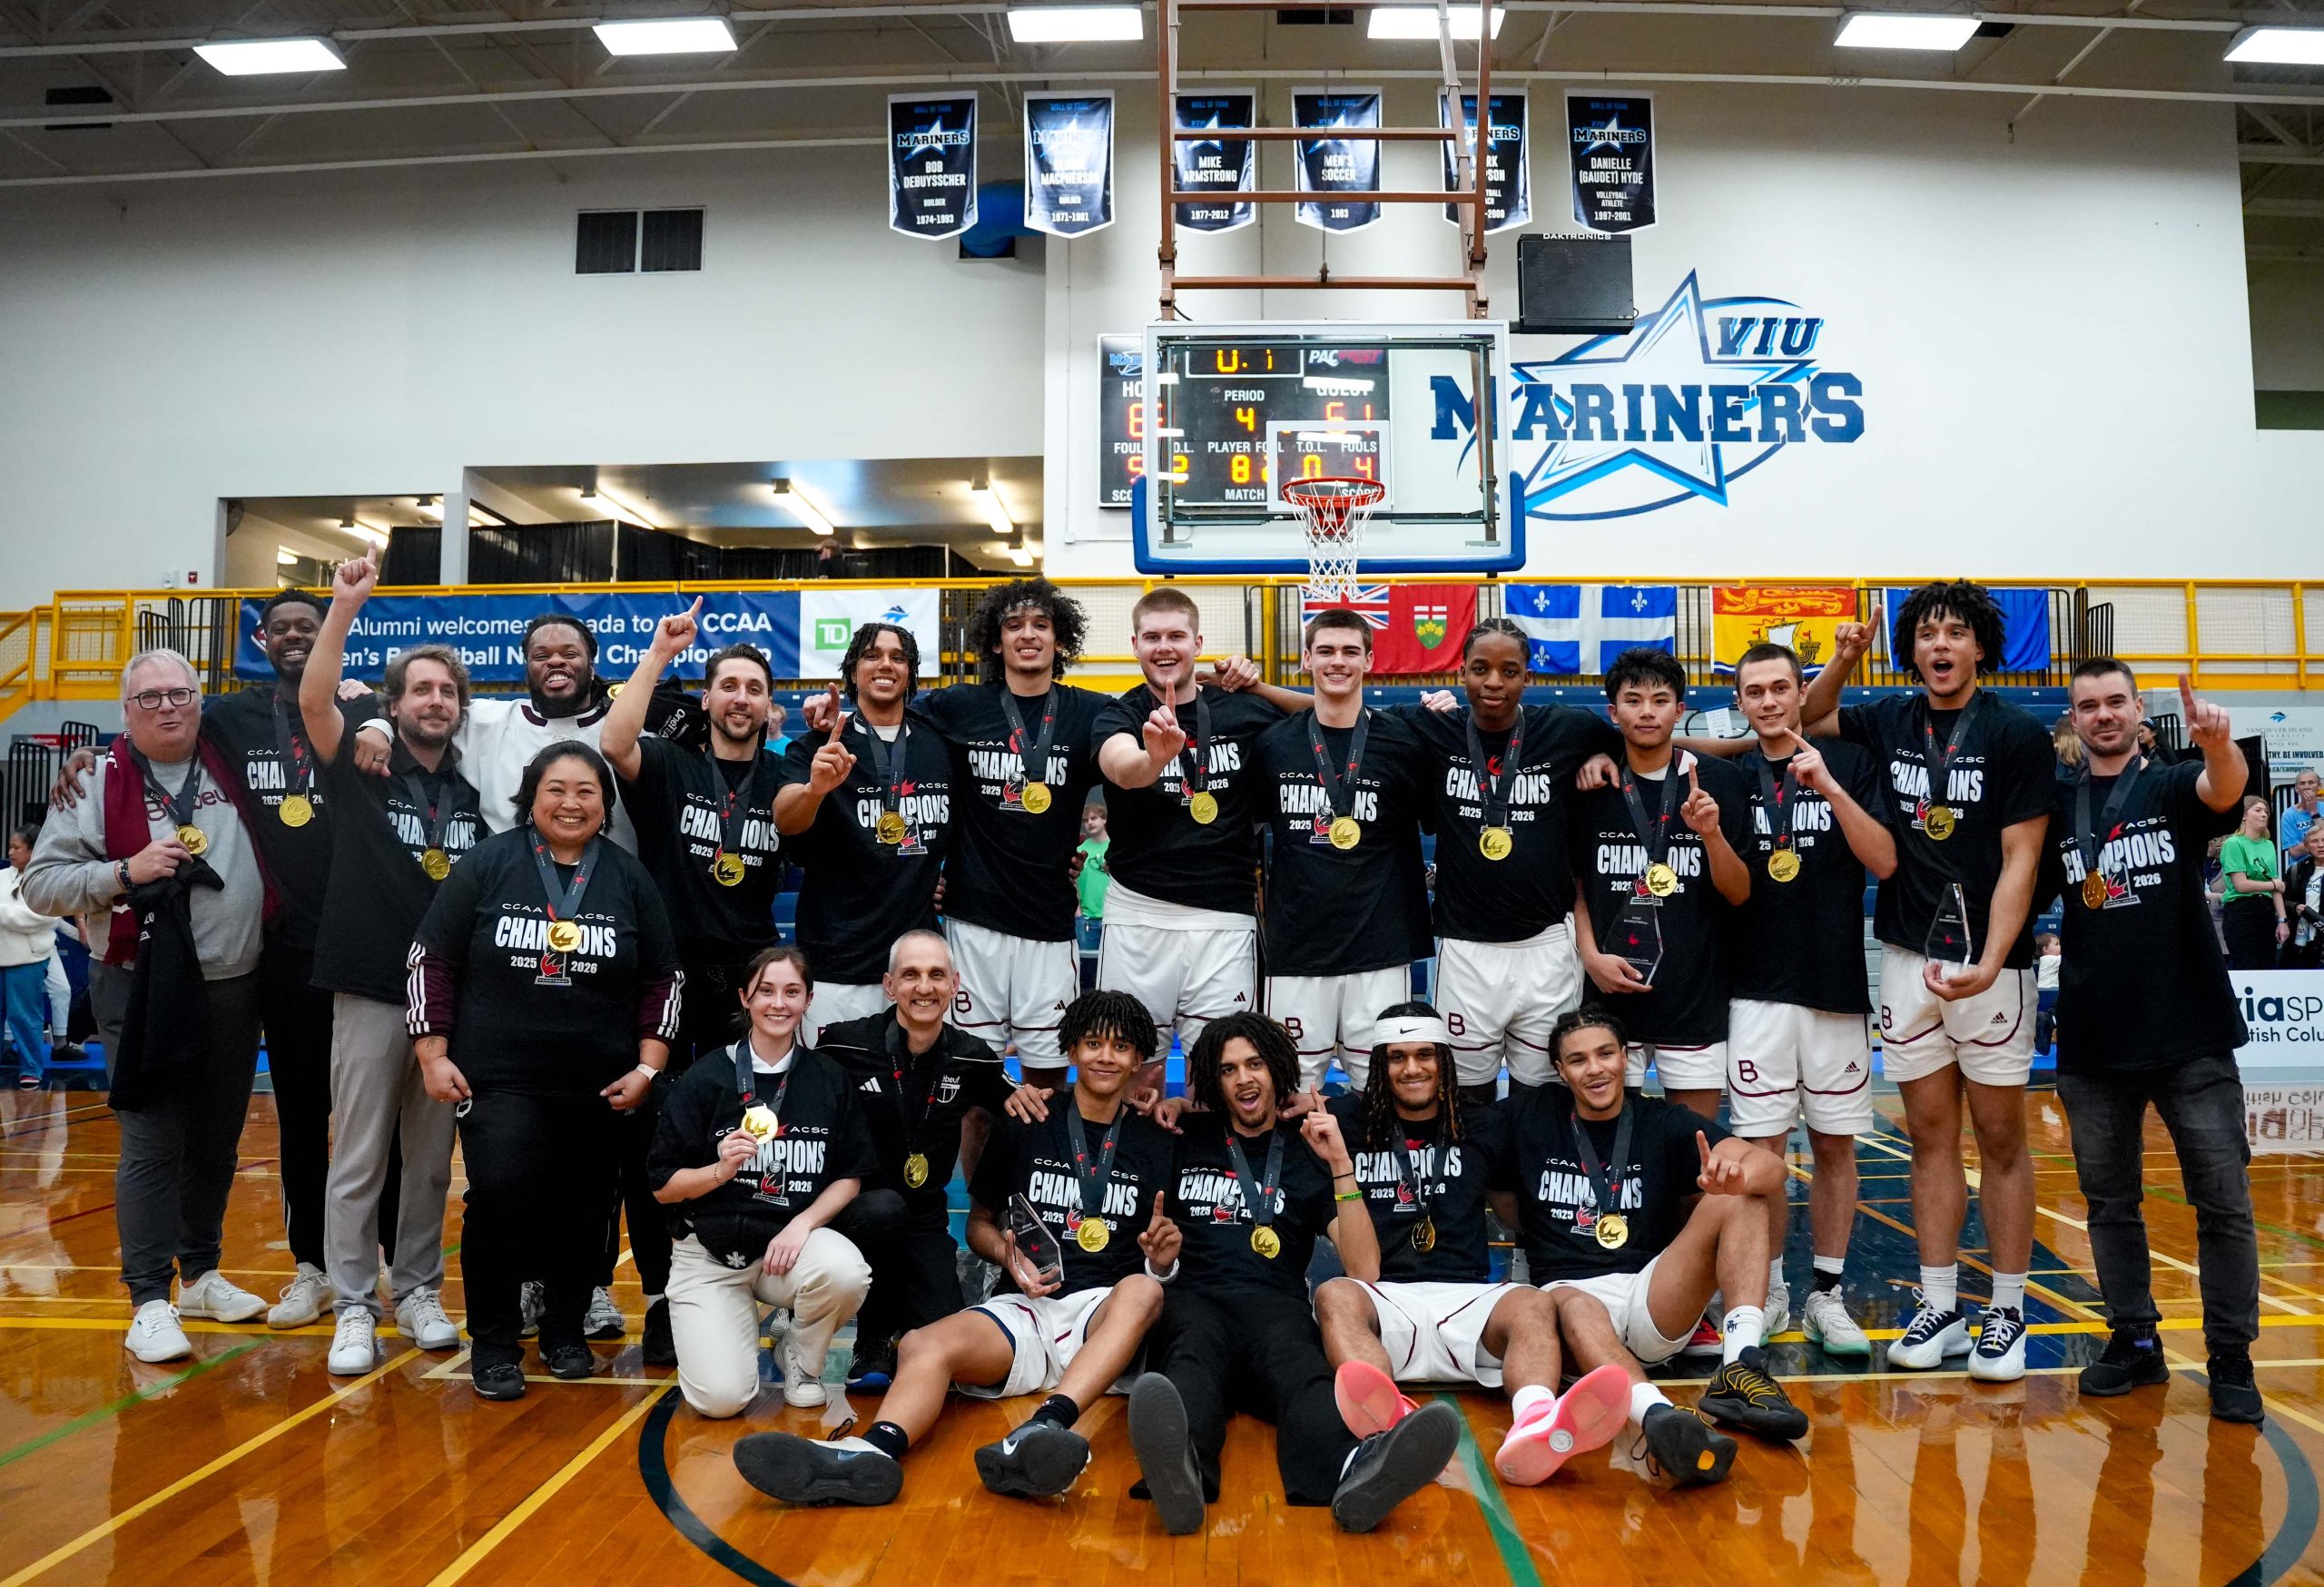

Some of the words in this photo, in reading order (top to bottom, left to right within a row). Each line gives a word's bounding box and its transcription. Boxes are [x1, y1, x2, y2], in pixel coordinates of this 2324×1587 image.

[1191, 100, 1206, 108] WALL
[1215, 100, 1229, 108] FAME
[897, 131, 970, 147] MARINERS
[1573, 127, 1646, 143] MARINERS
[925, 161, 943, 173] BOB
[1198, 155, 1222, 168] MIKE
[1324, 154, 1353, 167] MEN'S
[1472, 154, 1498, 168] MRK
[1590, 157, 1631, 170] DANIELLE
[903, 173, 966, 189] DEBUYSSCHER
[1183, 169, 1237, 182] ARMSTRONG
[1322, 169, 1355, 181] SOCCER
[1579, 170, 1619, 184] (GAUDET)
[1620, 172, 1643, 184] HYDE
[923, 198, 946, 207] BUILDER
[1059, 196, 1081, 204] BUILDER
[1596, 191, 1628, 201] VOLLEYBALL
[1600, 199, 1623, 207] ATHLETE
[1191, 210, 1229, 220] 1977-2012
[1594, 211, 1631, 221] 1997-2001
[1542, 232, 1611, 241] DAKTRONICS
[1717, 317, 1824, 358] VIU
[1225, 389, 1265, 401] PERIOD
[1430, 371, 1865, 444] MARINERS
[1236, 407, 1255, 431] 4
[1114, 442, 1143, 454] FOUL
[1207, 441, 1250, 453] PLAYER
[1256, 441, 1285, 453] FOL
[1296, 441, 1327, 453] T.O.L.
[1341, 441, 1377, 453] FOULS
[1231, 455, 1250, 483] 8
[1355, 457, 1372, 479] 4
[1112, 489, 1133, 501] SCO
[1226, 489, 1265, 500] MATCH
[348, 616, 421, 636] Alumni
[427, 616, 532, 636] welcomes
[585, 613, 625, 634] ada
[633, 613, 654, 633] to
[703, 612, 773, 632] CCAA
[819, 624, 848, 645] TD
[341, 647, 379, 667] en's
[386, 645, 499, 665] Btball
[661, 708, 685, 738] OneTEA
[1450, 755, 1472, 764] CC
[968, 750, 1068, 786] CHAMNS
[1207, 778, 1229, 790] 2026
[1356, 778, 1381, 787] SC
[1446, 766, 1551, 804] CHAIONS
[1890, 761, 1984, 803] CHAMONS
[981, 784, 1001, 795] 2025
[261, 795, 284, 805] 2025
[1279, 784, 1378, 822] CHAMNS
[748, 807, 772, 815] ACS
[857, 795, 950, 828] CHPIONS
[1459, 805, 1482, 818] 2025
[1511, 811, 1535, 822] 2026
[1948, 807, 1964, 820] 26
[680, 804, 780, 853] CHAIONS
[1289, 820, 1312, 830] 2025
[2126, 815, 2167, 830] ACSC
[387, 811, 477, 850] CHAIONS
[1759, 840, 1771, 851] 25
[690, 843, 714, 858] 2025
[742, 854, 763, 867] 2026
[1597, 844, 1701, 877] CHAMONS
[2062, 830, 2176, 885] CHMPIONS
[2133, 872, 2162, 888] 2026
[1674, 882, 1685, 893] 26
[502, 903, 543, 913] CCAA
[575, 913, 615, 922] ACSC
[495, 915, 616, 959] CHAMONS
[510, 956, 537, 969] 2025
[570, 961, 598, 974] 2026
[2250, 1027, 2280, 1042] tish
[715, 1127, 735, 1136] CC
[737, 1140, 826, 1174] AMPIONS
[1546, 1158, 1579, 1169] CAA
[1034, 1158, 1070, 1170] CCAA
[1111, 1170, 1139, 1181] CSC
[1354, 1146, 1462, 1183] CHAPIOS
[788, 1180, 812, 1192] 2026
[1370, 1188, 1394, 1198] 2025
[1424, 1183, 1446, 1196] 26
[1539, 1170, 1642, 1209] CHAMNS
[1029, 1170, 1138, 1217] CHAMONS
[1178, 1174, 1286, 1215] CHAMPS
[1189, 1206, 1212, 1217] 2025
[1240, 1209, 1253, 1218] 20
[1550, 1208, 1574, 1220] 2025
[1042, 1211, 1064, 1224] 2025
[1102, 1218, 1118, 1231] 26
